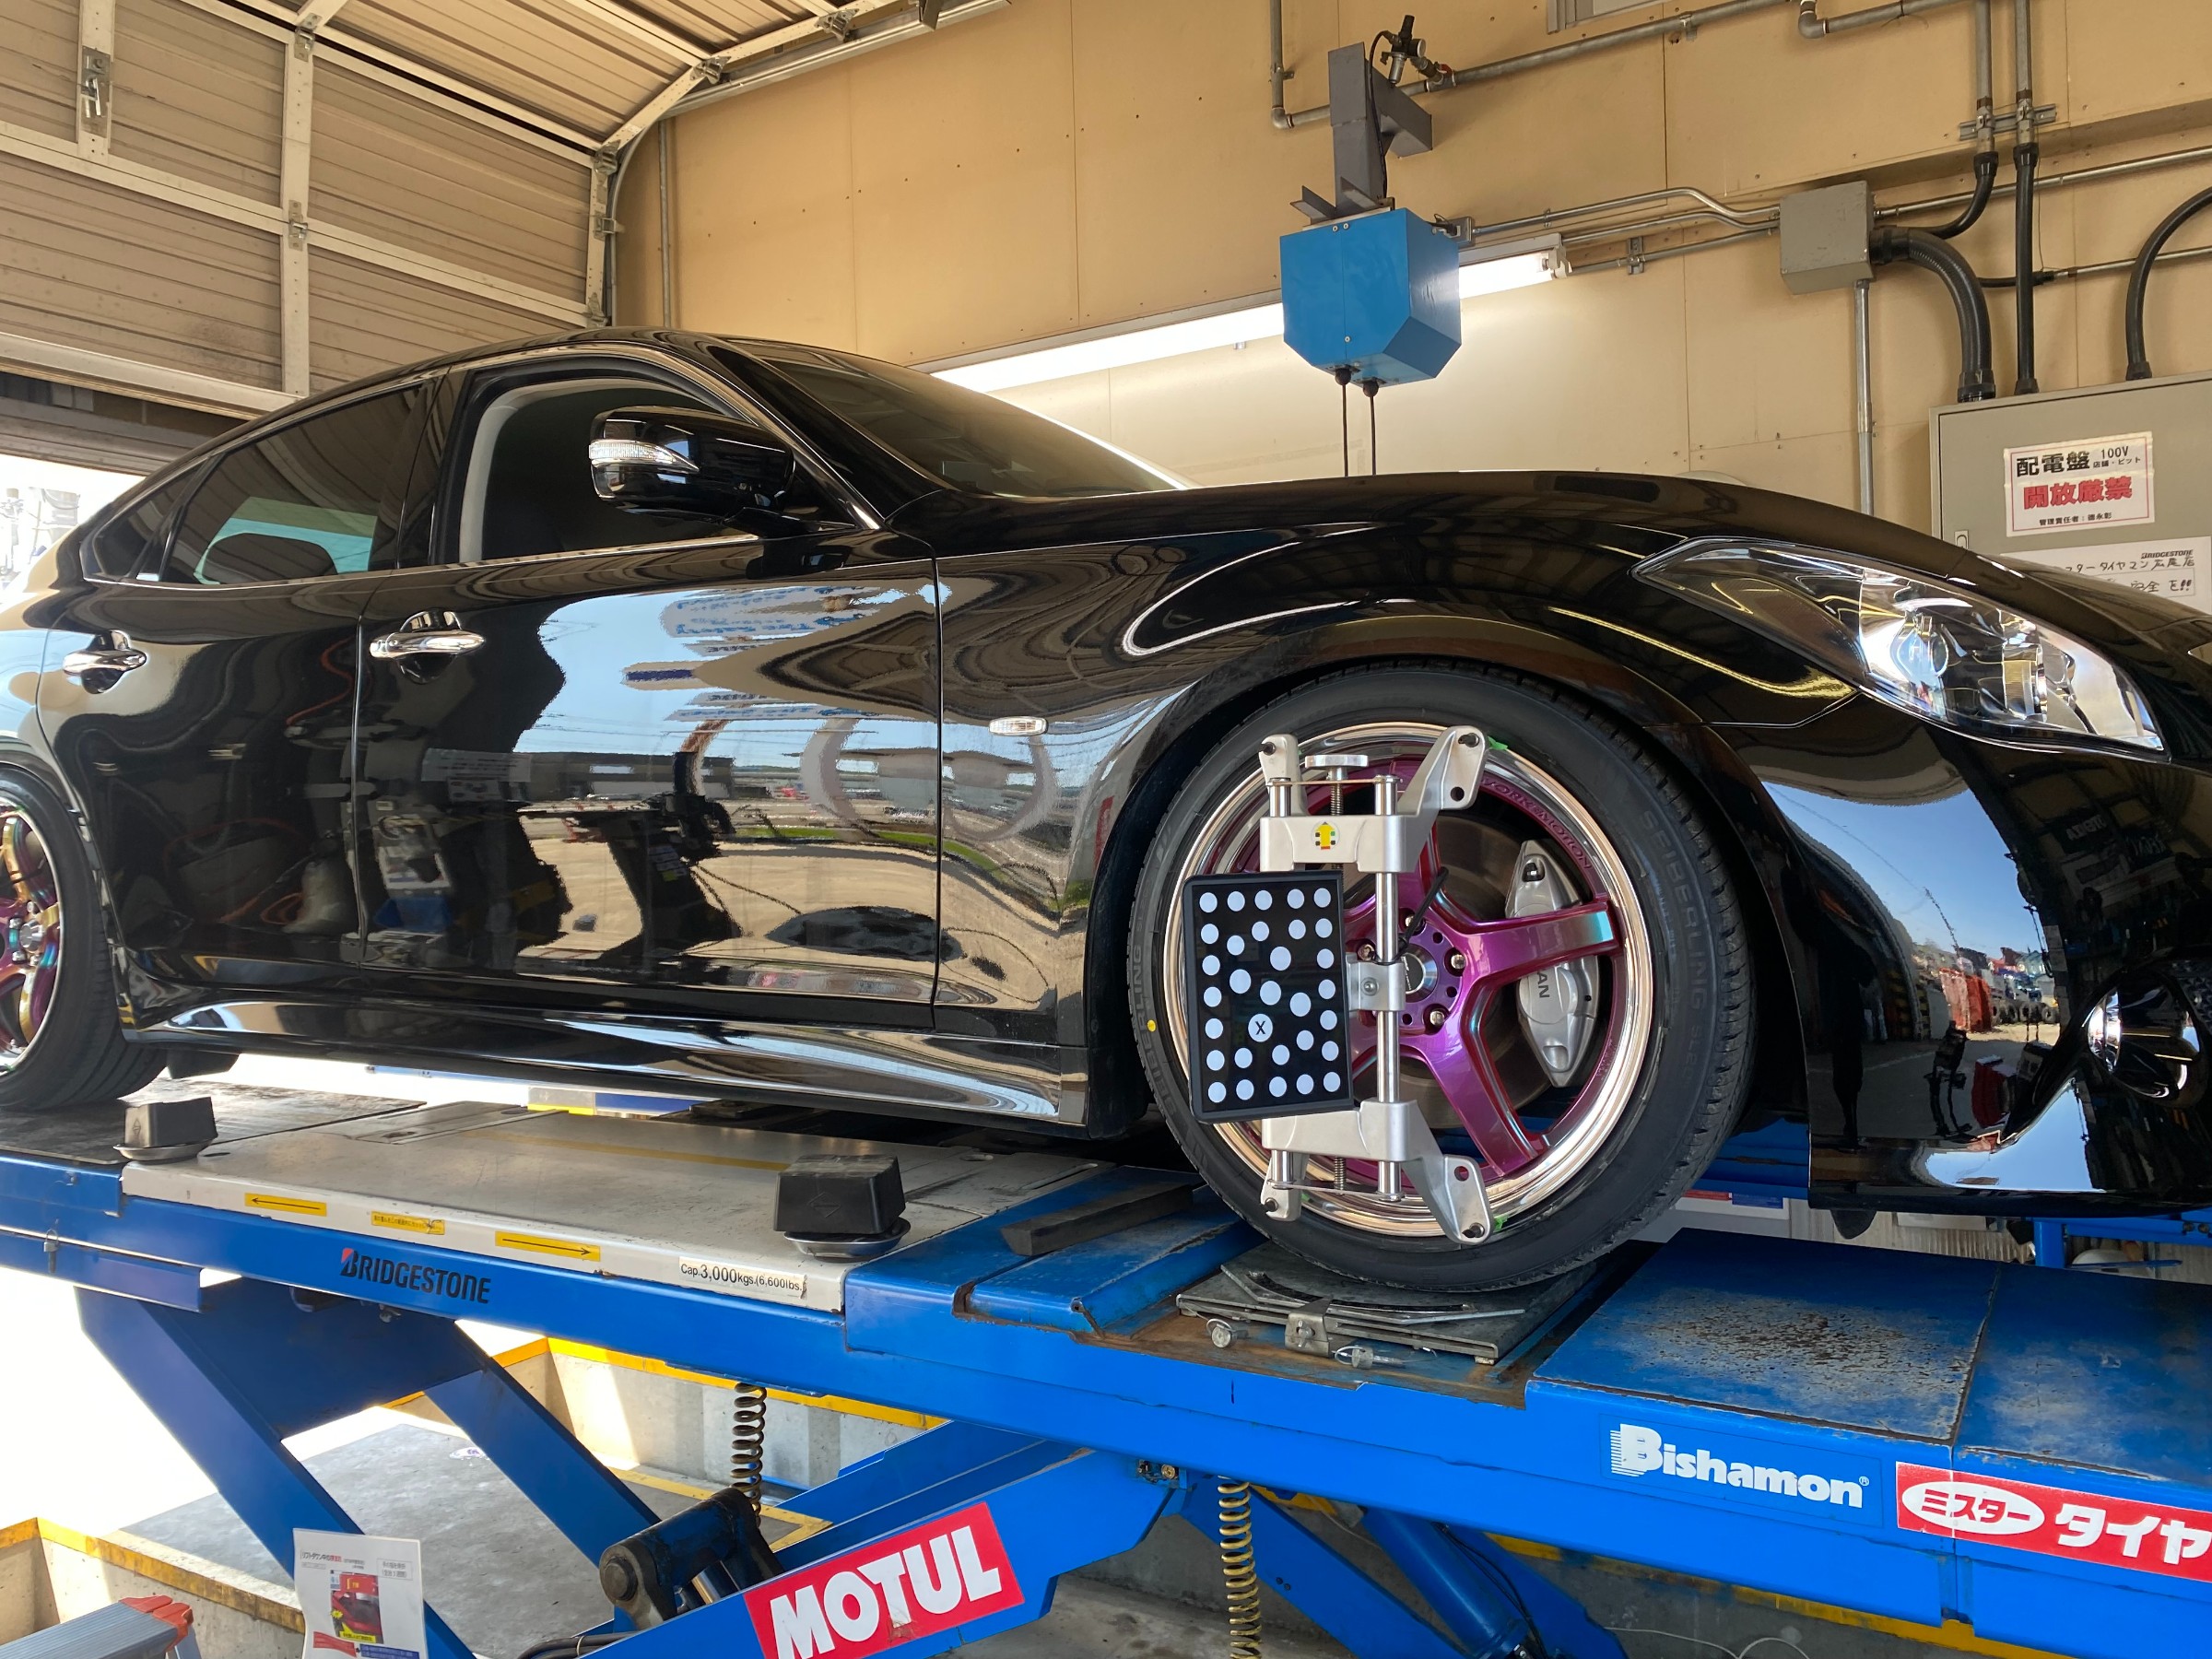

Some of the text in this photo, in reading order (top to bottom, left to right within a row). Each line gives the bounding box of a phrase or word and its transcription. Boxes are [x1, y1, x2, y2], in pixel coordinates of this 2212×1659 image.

[2017, 451, 2090, 477] 配電盤
[2100, 446, 2129, 460] 100V
[2023, 476, 2133, 510] 開放厳禁
[2141, 549, 2194, 559] BRIDGESTONE
[1643, 810, 1706, 1010] SEIBERLING
[1133, 944, 1177, 1116] SEIBERLING
[1254, 1020, 1266, 1036] X
[340, 1247, 492, 1304] BRIDGESTONE
[1610, 1423, 1864, 1509] Bishamon
[1921, 1488, 2212, 1565] ミスター タイヤ
[770, 1525, 1003, 1659] MOTUL
